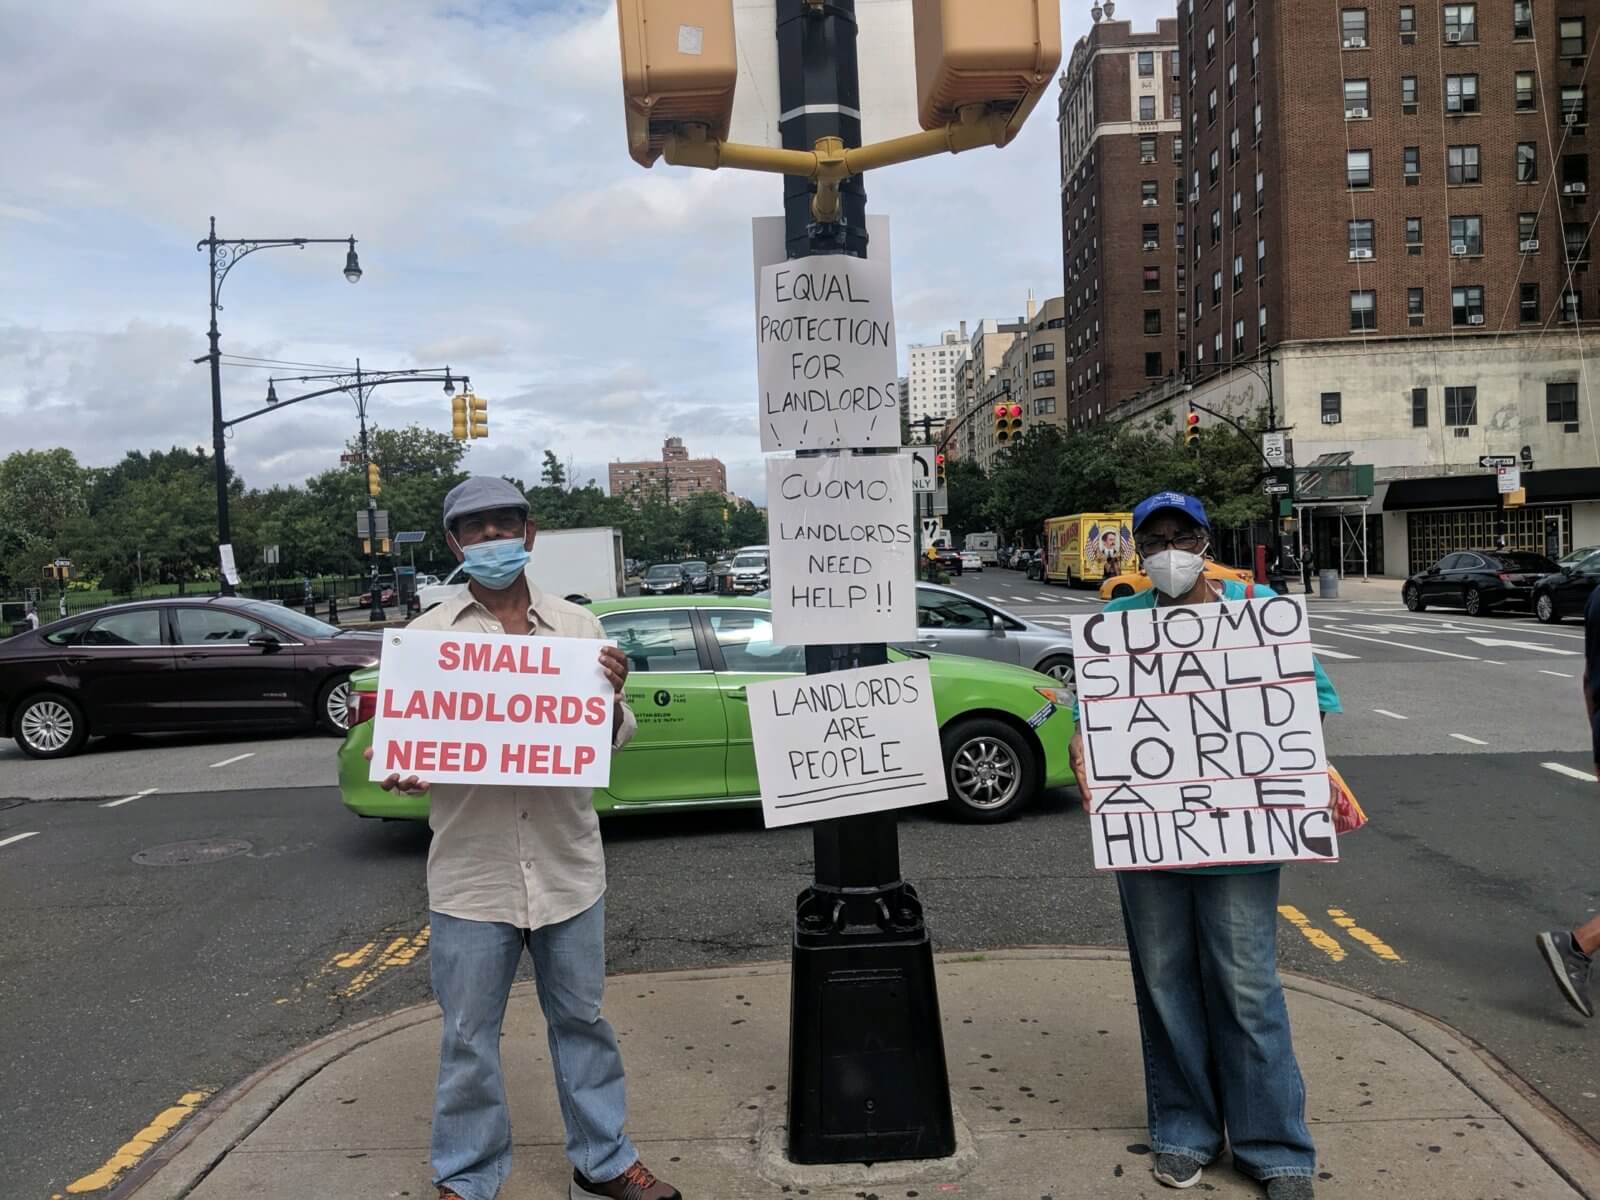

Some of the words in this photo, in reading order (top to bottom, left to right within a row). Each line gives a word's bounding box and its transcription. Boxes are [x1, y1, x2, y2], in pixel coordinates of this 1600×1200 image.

[775, 271, 870, 302] EQUAL
[761, 315, 889, 347] PROTECTION
[792, 353, 844, 380] FOR
[767, 383, 896, 414] LANDLORDS
[1266, 446, 1282, 457] 25
[781, 473, 893, 503] CUOMO,
[912, 479, 931, 489] NLY
[780, 522, 912, 544] LANDLORDS
[809, 555, 872, 575] NEED
[1083, 596, 1302, 654] CUOMO
[438, 641, 561, 675] SMALL
[1081, 645, 1315, 698] SMALL
[383, 688, 606, 725] LANDLORDS
[773, 675, 919, 716] LANDLORDS
[1084, 686, 1295, 735] LAND
[824, 716, 876, 743] ARE
[385, 740, 487, 773] NEED
[500, 743, 596, 775] HELP
[788, 741, 902, 780] PEOPLE
[1088, 731, 1316, 781] LORDS
[1096, 779, 1305, 813] ARE
[1100, 808, 1334, 866] HURTING
